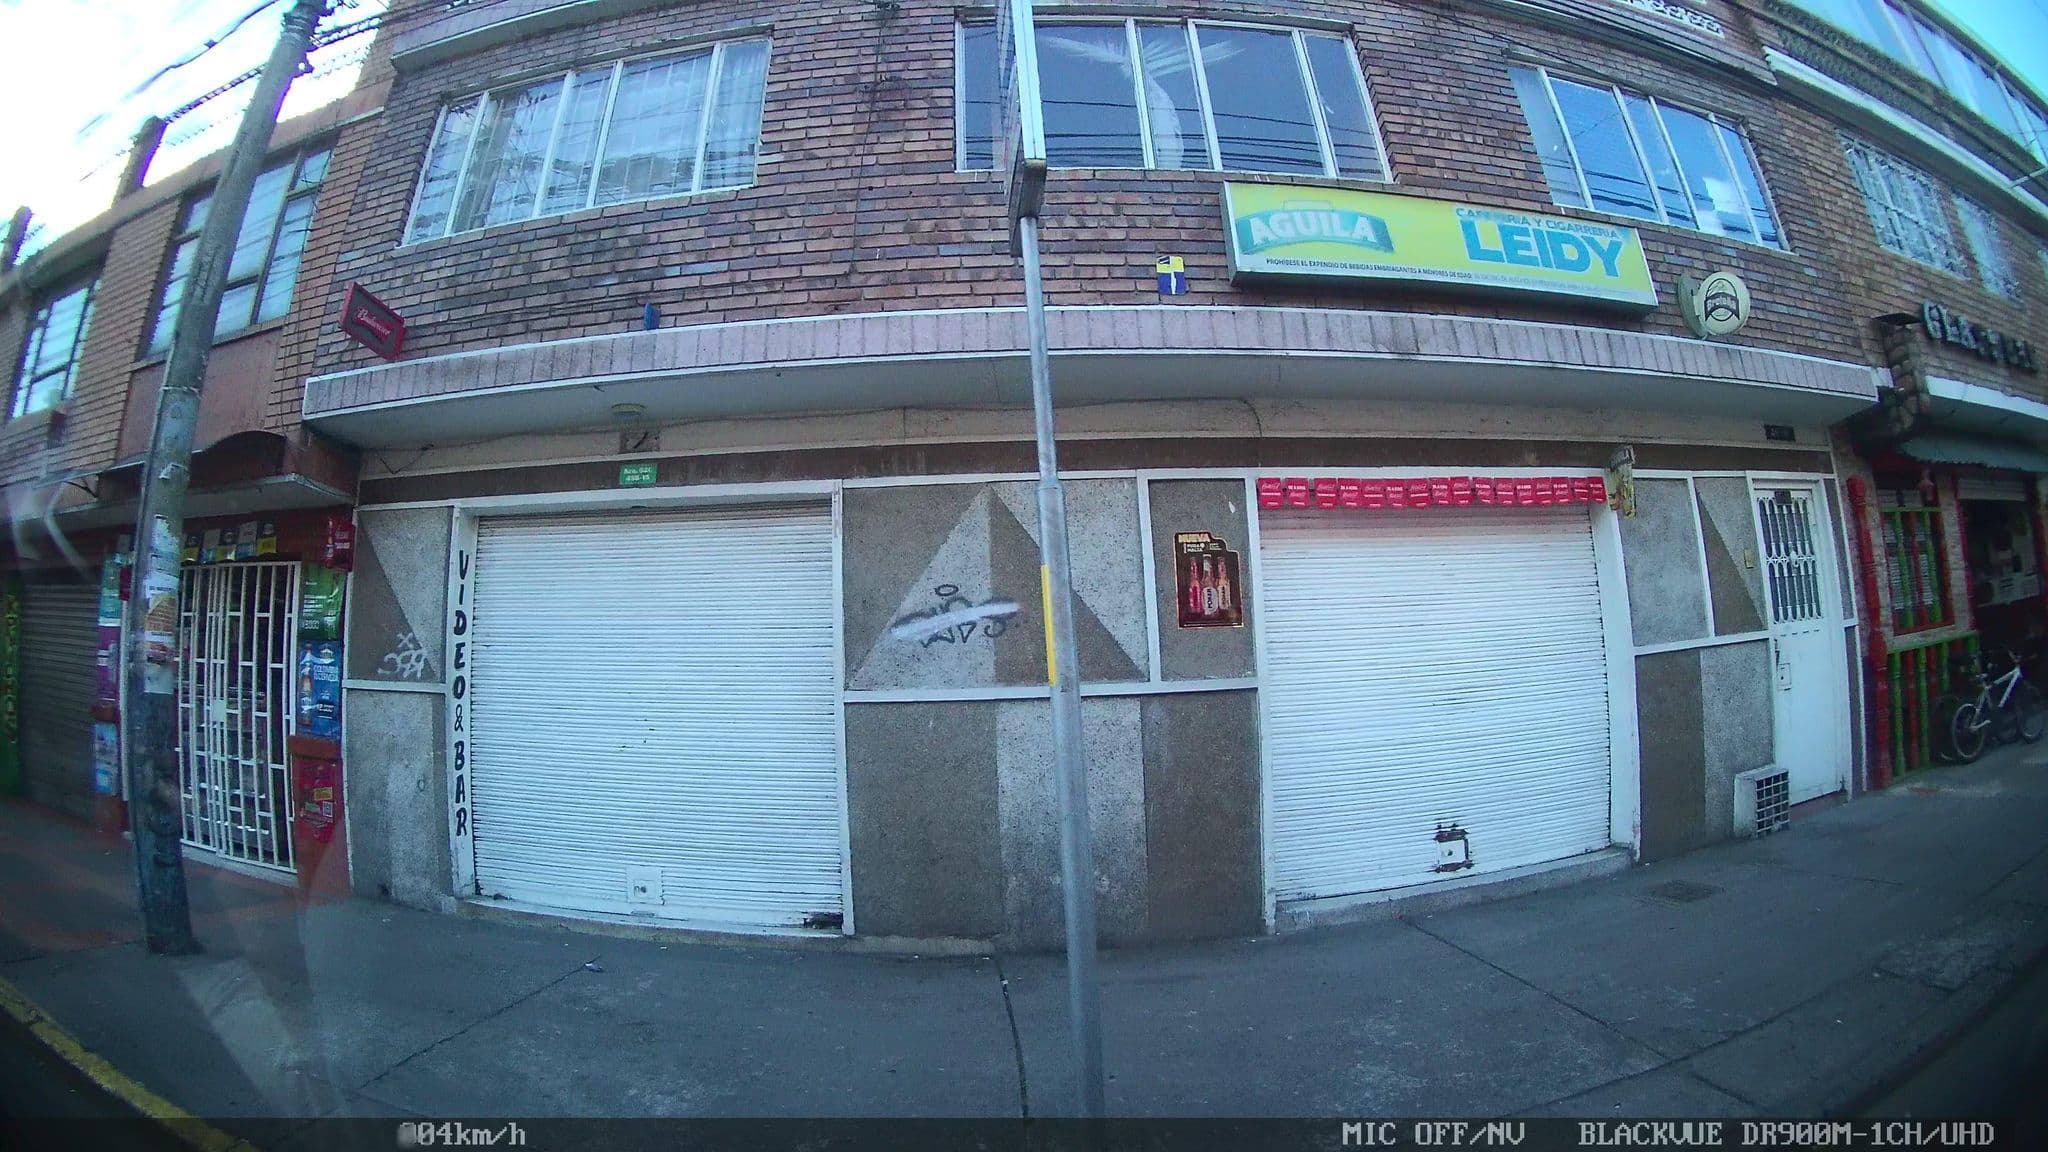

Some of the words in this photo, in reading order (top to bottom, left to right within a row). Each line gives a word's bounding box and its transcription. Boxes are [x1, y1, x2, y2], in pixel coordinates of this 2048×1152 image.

[1249, 210, 1377, 246] AGUILA
[1534, 214, 1544, 225] Y
[1459, 218, 1623, 278] LEIDY
